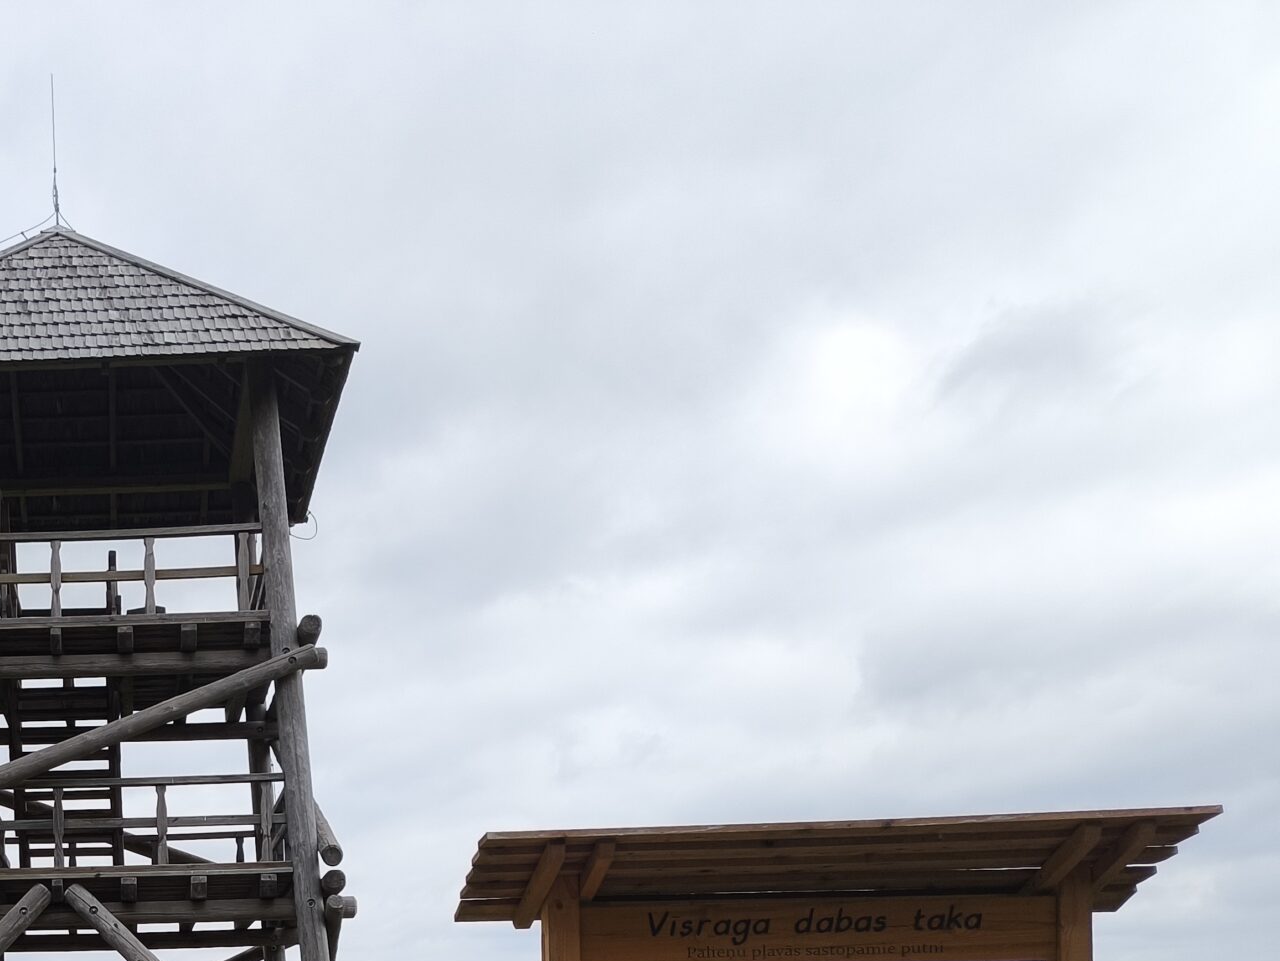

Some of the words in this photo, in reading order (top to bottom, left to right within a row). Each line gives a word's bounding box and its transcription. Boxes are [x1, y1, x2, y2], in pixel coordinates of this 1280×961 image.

[647, 911, 770, 946] Vīsraga
[794, 907, 887, 934] dabas
[913, 904, 983, 931] taka
[805, 944, 895, 959] sastopamie
[901, 942, 944, 957] putni
